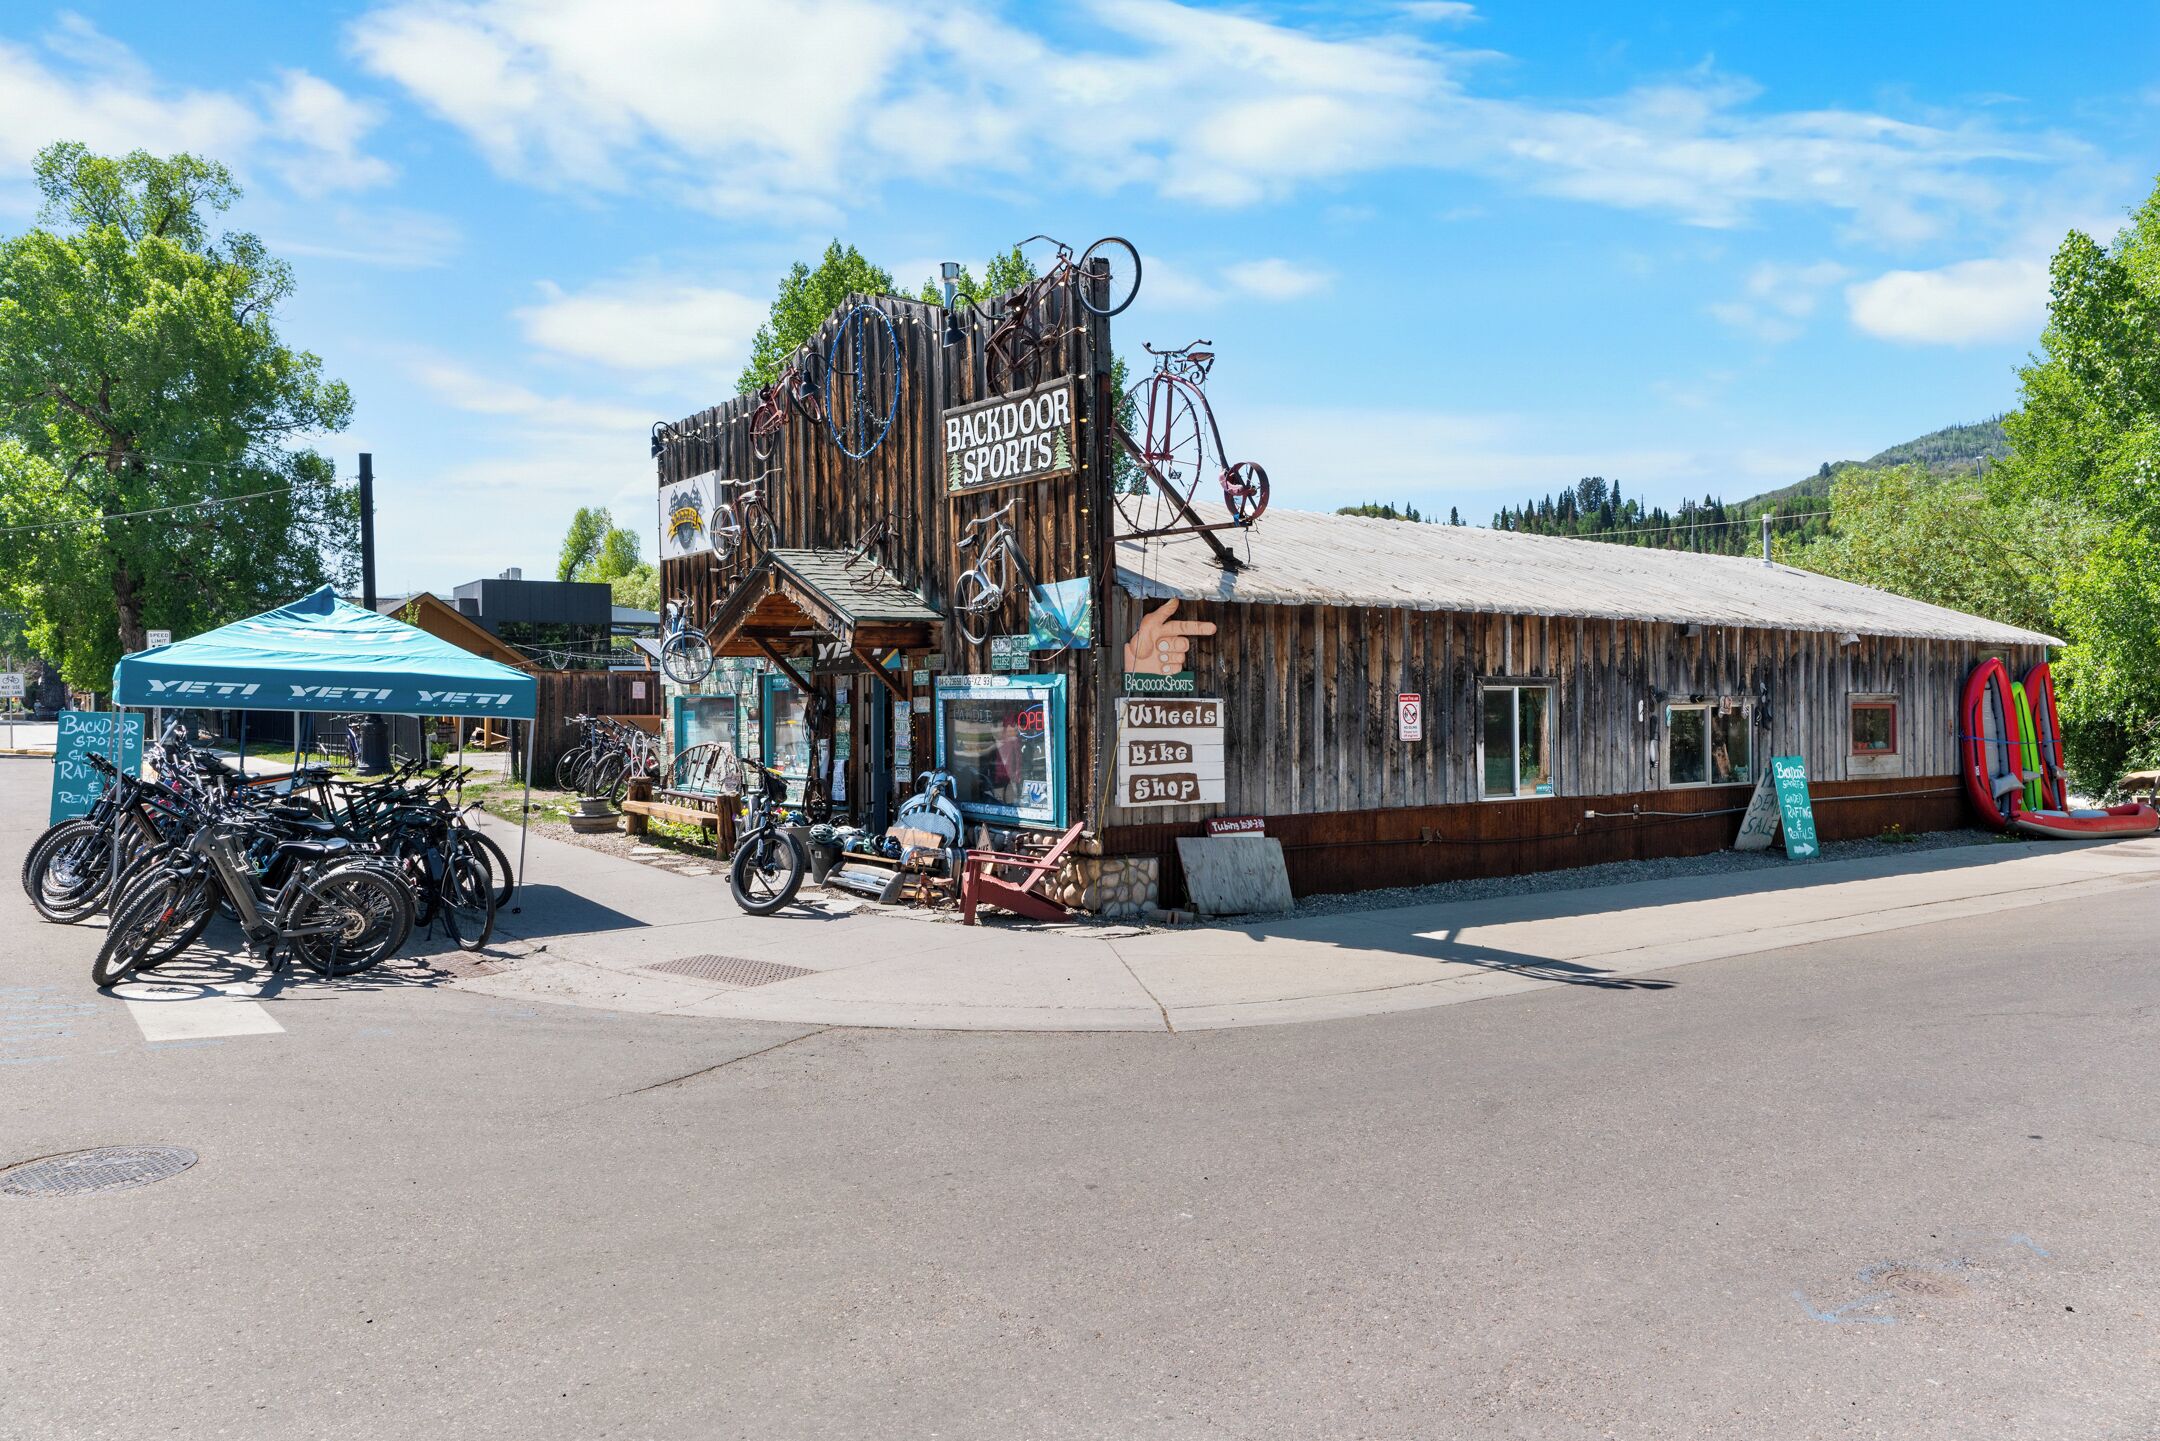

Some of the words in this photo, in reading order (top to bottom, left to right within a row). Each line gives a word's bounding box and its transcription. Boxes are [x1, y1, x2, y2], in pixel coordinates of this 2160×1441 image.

[946, 388, 1071, 453] BACKDOOR
[963, 431, 1052, 484] SPORTS
[147, 679, 261, 695] YETI
[289, 685, 393, 700] YETI
[417, 690, 513, 705] YETI
[1129, 704, 1216, 727] Wheels
[1131, 743, 1188, 765] Bike
[1134, 778, 1195, 800] Shop
[1211, 821, 1240, 832] Tubing
[1741, 816, 1777, 836] SALE
